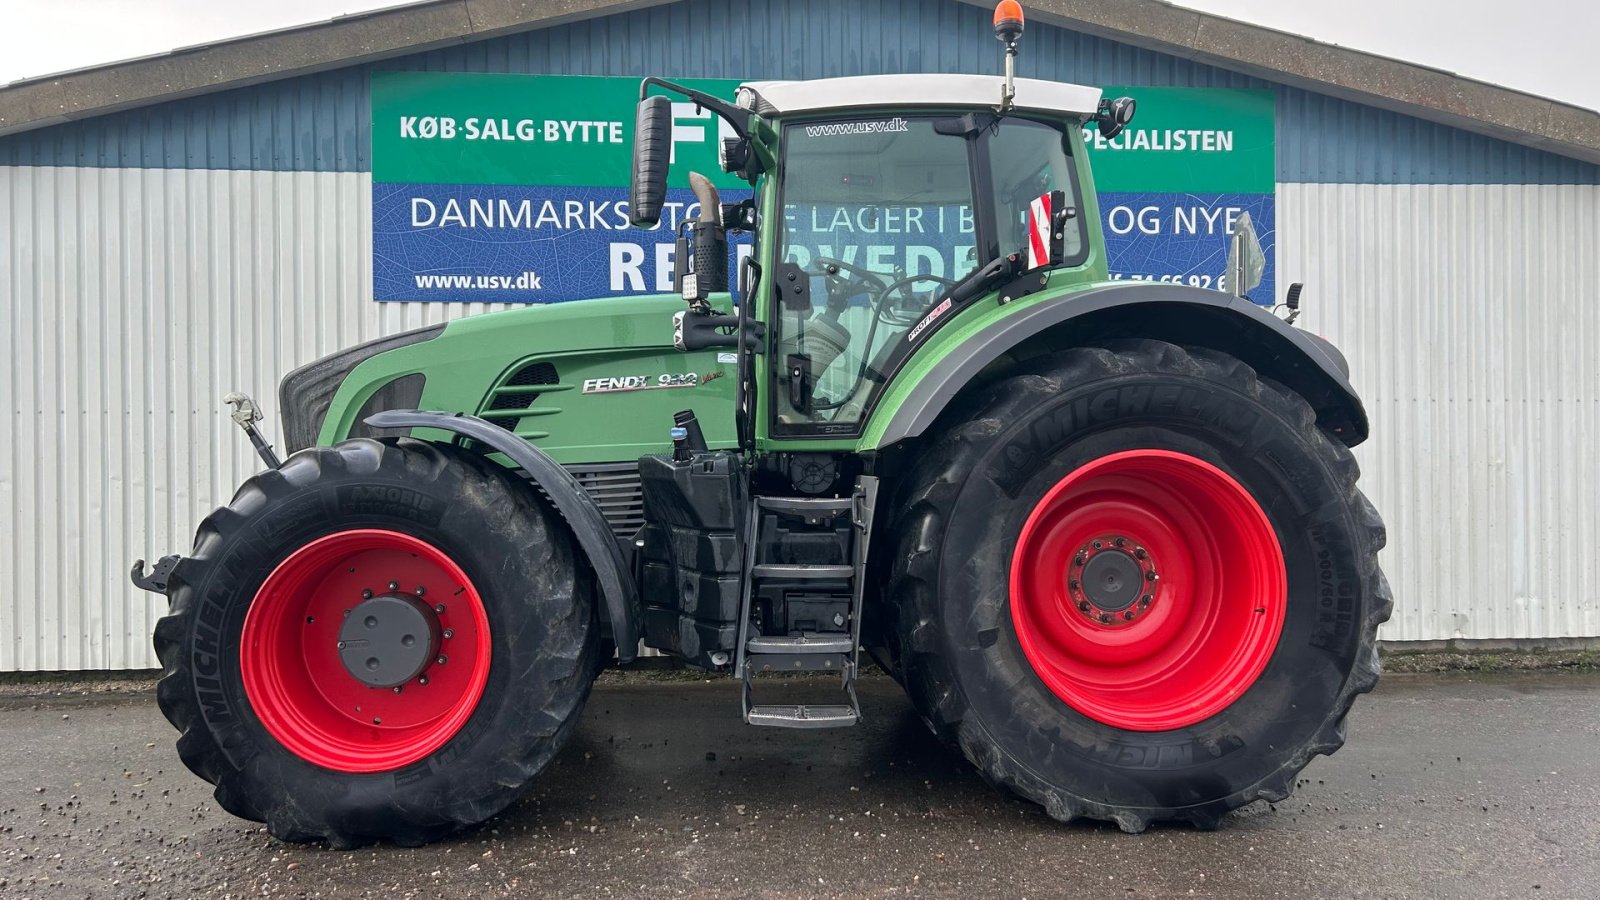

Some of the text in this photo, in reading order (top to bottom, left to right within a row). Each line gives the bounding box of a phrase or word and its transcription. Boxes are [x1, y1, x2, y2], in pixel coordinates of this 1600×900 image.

[806, 118, 908, 137] www.usv.dk
[1082, 129, 1233, 151] PECIALISTEN
[411, 198, 631, 231] DANMARKS
[811, 205, 925, 233] LAGER
[1108, 205, 1160, 234] OG
[415, 271, 541, 290] www.usv.dk
[583, 375, 651, 393] FENDT
[1034, 385, 1260, 448] MICHELIN
[192, 545, 253, 724] MICHELIN
